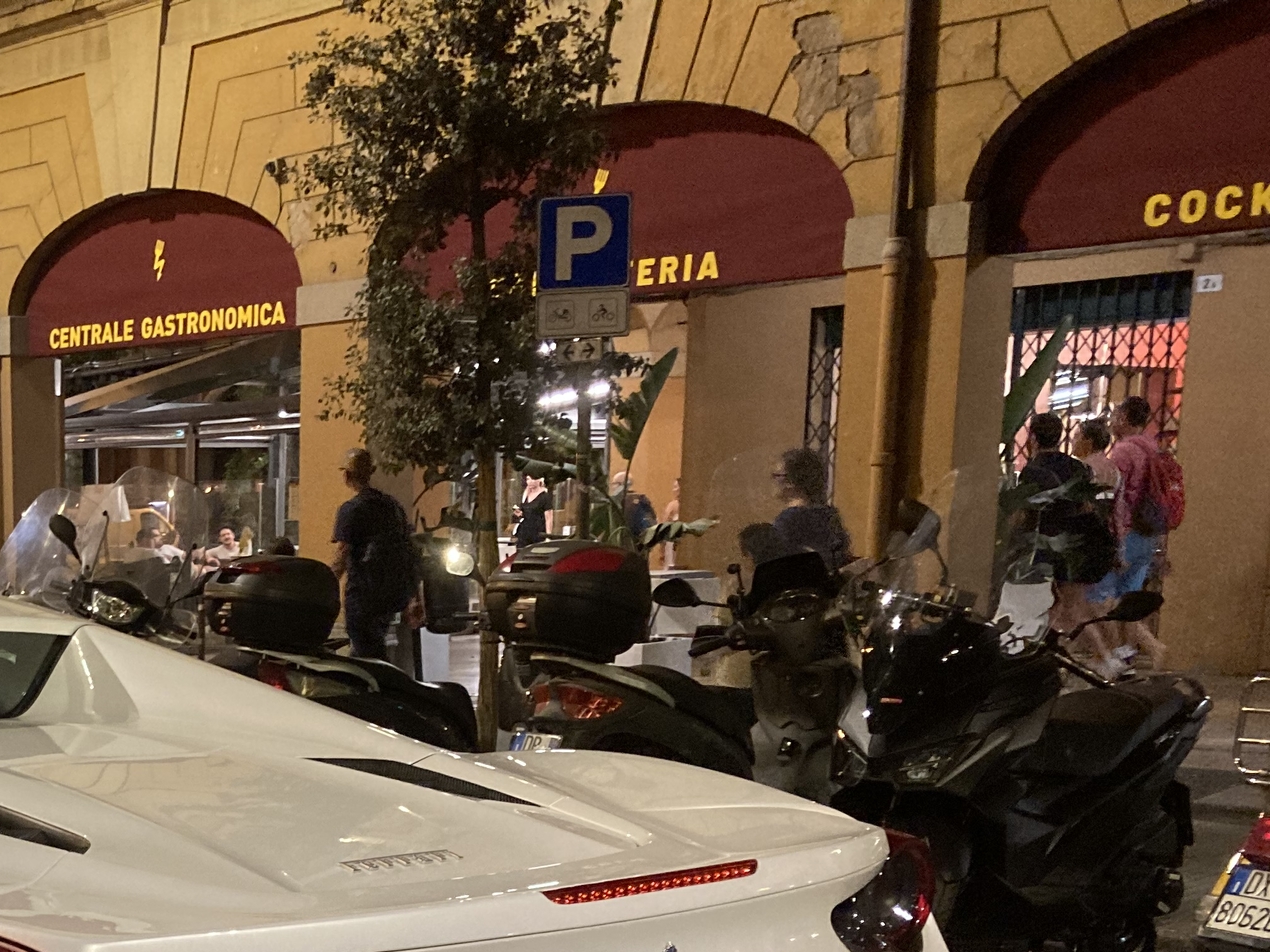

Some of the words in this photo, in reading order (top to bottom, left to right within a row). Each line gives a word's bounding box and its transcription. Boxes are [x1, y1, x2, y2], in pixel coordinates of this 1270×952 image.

[555, 205, 613, 281] P
[49, 318, 134, 350] CENTRALE
[141, 301, 285, 339] GASTRONOMICA
